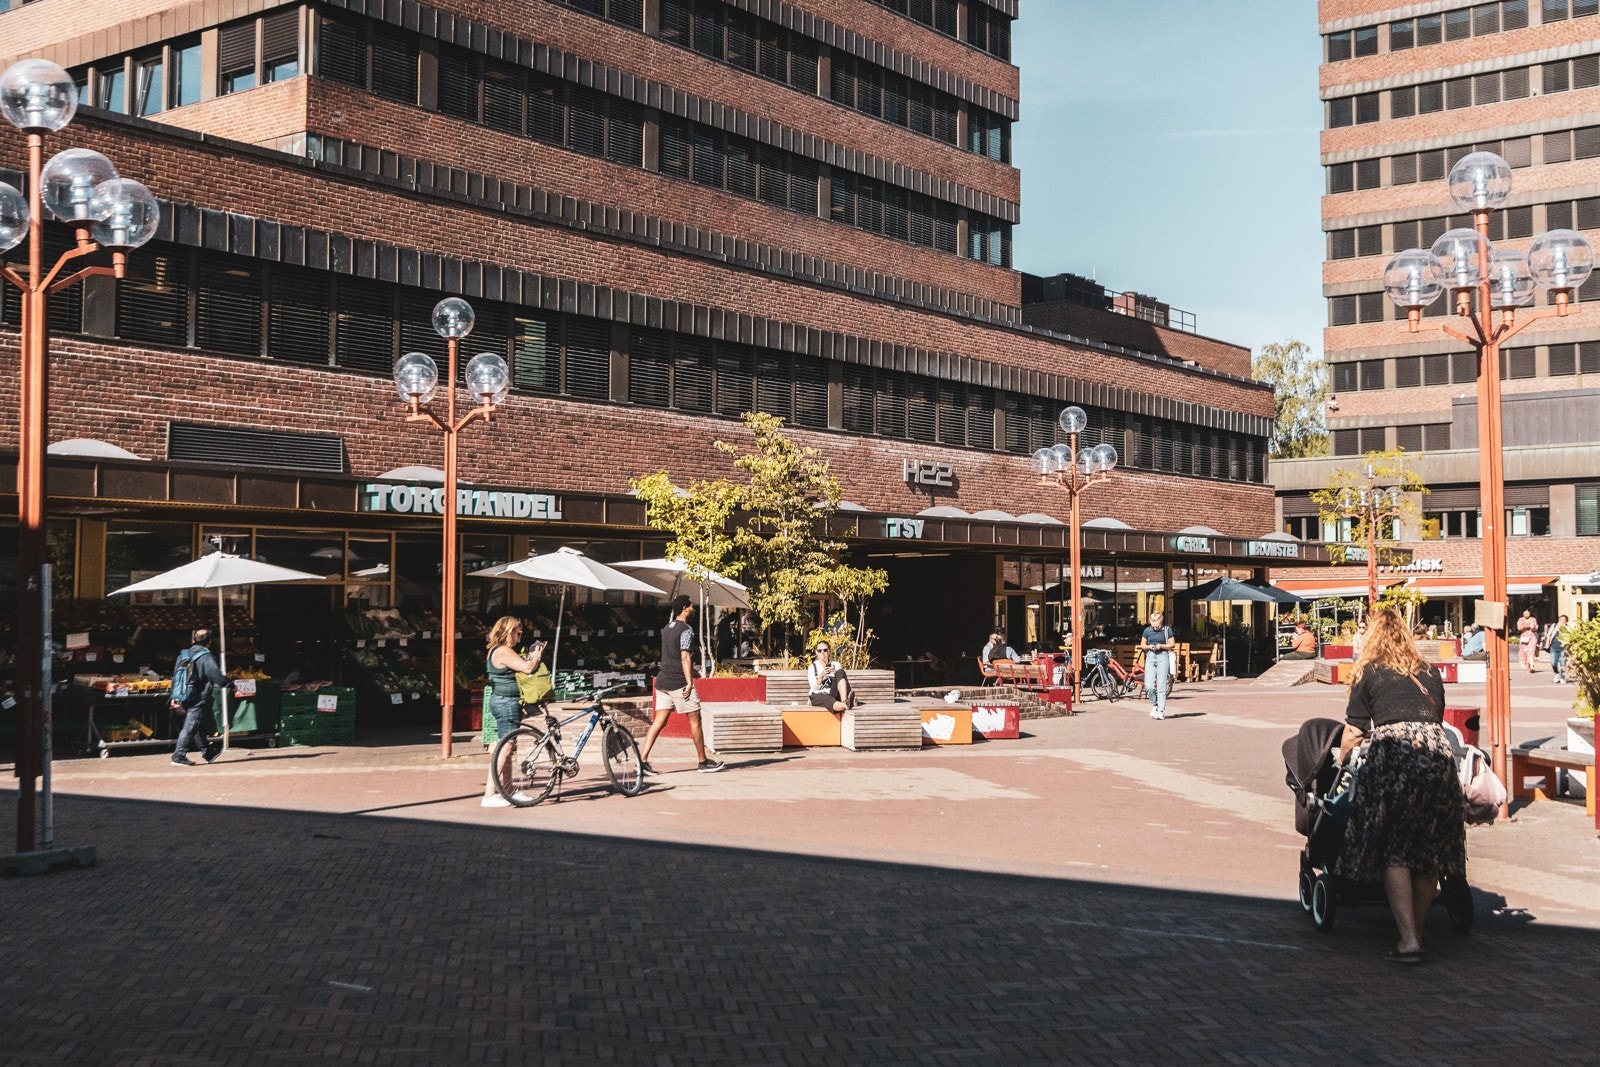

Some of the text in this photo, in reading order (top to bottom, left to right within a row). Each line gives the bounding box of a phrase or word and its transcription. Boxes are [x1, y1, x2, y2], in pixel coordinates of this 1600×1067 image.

[903, 458, 953, 487] H22
[367, 484, 562, 520] TORGHANDEL
[886, 518, 925, 539] TSV
[1178, 536, 1211, 553] GRILL
[1250, 541, 1299, 558] BLOMSTER
